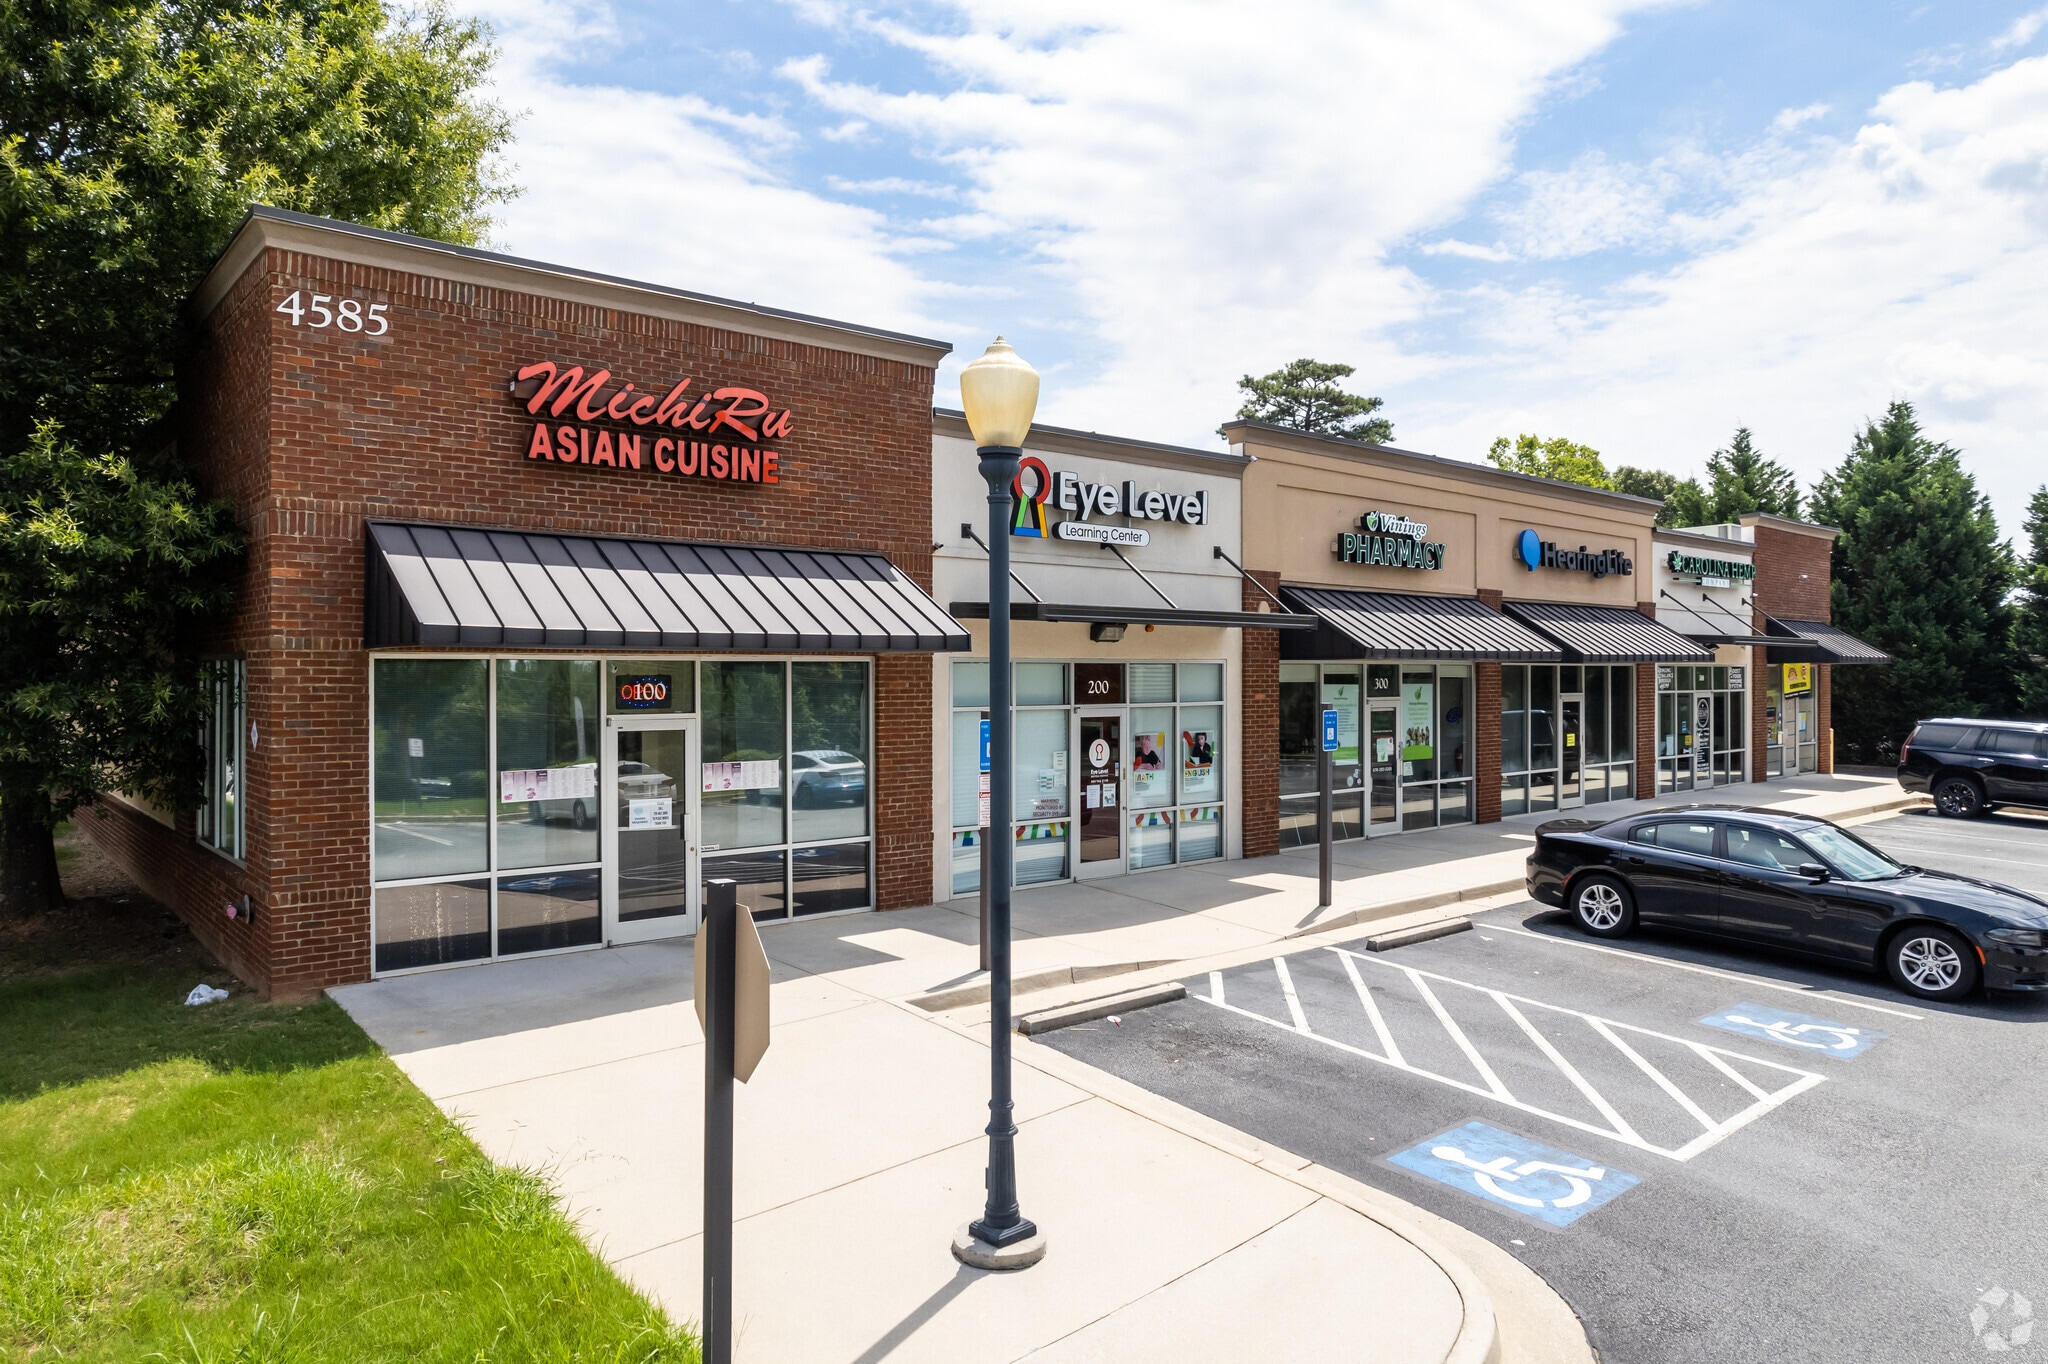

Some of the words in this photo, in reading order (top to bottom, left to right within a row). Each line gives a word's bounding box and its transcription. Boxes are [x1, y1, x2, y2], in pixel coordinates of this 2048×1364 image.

[276, 290, 389, 336] 4585
[517, 360, 794, 442] MichiRu
[527, 423, 642, 470] ASIAN
[653, 437, 780, 484] CUISINE
[1057, 471, 1119, 521] Eye
[1125, 480, 1209, 525] Level
[1065, 524, 1109, 542] Learning
[1110, 528, 1143, 543] Center
[1380, 513, 1428, 540] Vinings
[1343, 532, 1447, 571] PHARMACY
[1542, 541, 1633, 579] HearingLife
[1682, 555, 1730, 577] CAROLINA
[1731, 561, 1757, 580] HEMP
[635, 682, 666, 700] 100
[1088, 680, 1109, 694] 200
[1374, 678, 1389, 690] 300
[1135, 773, 1154, 782] MATH
[1184, 768, 1210, 777] ENGLISH
